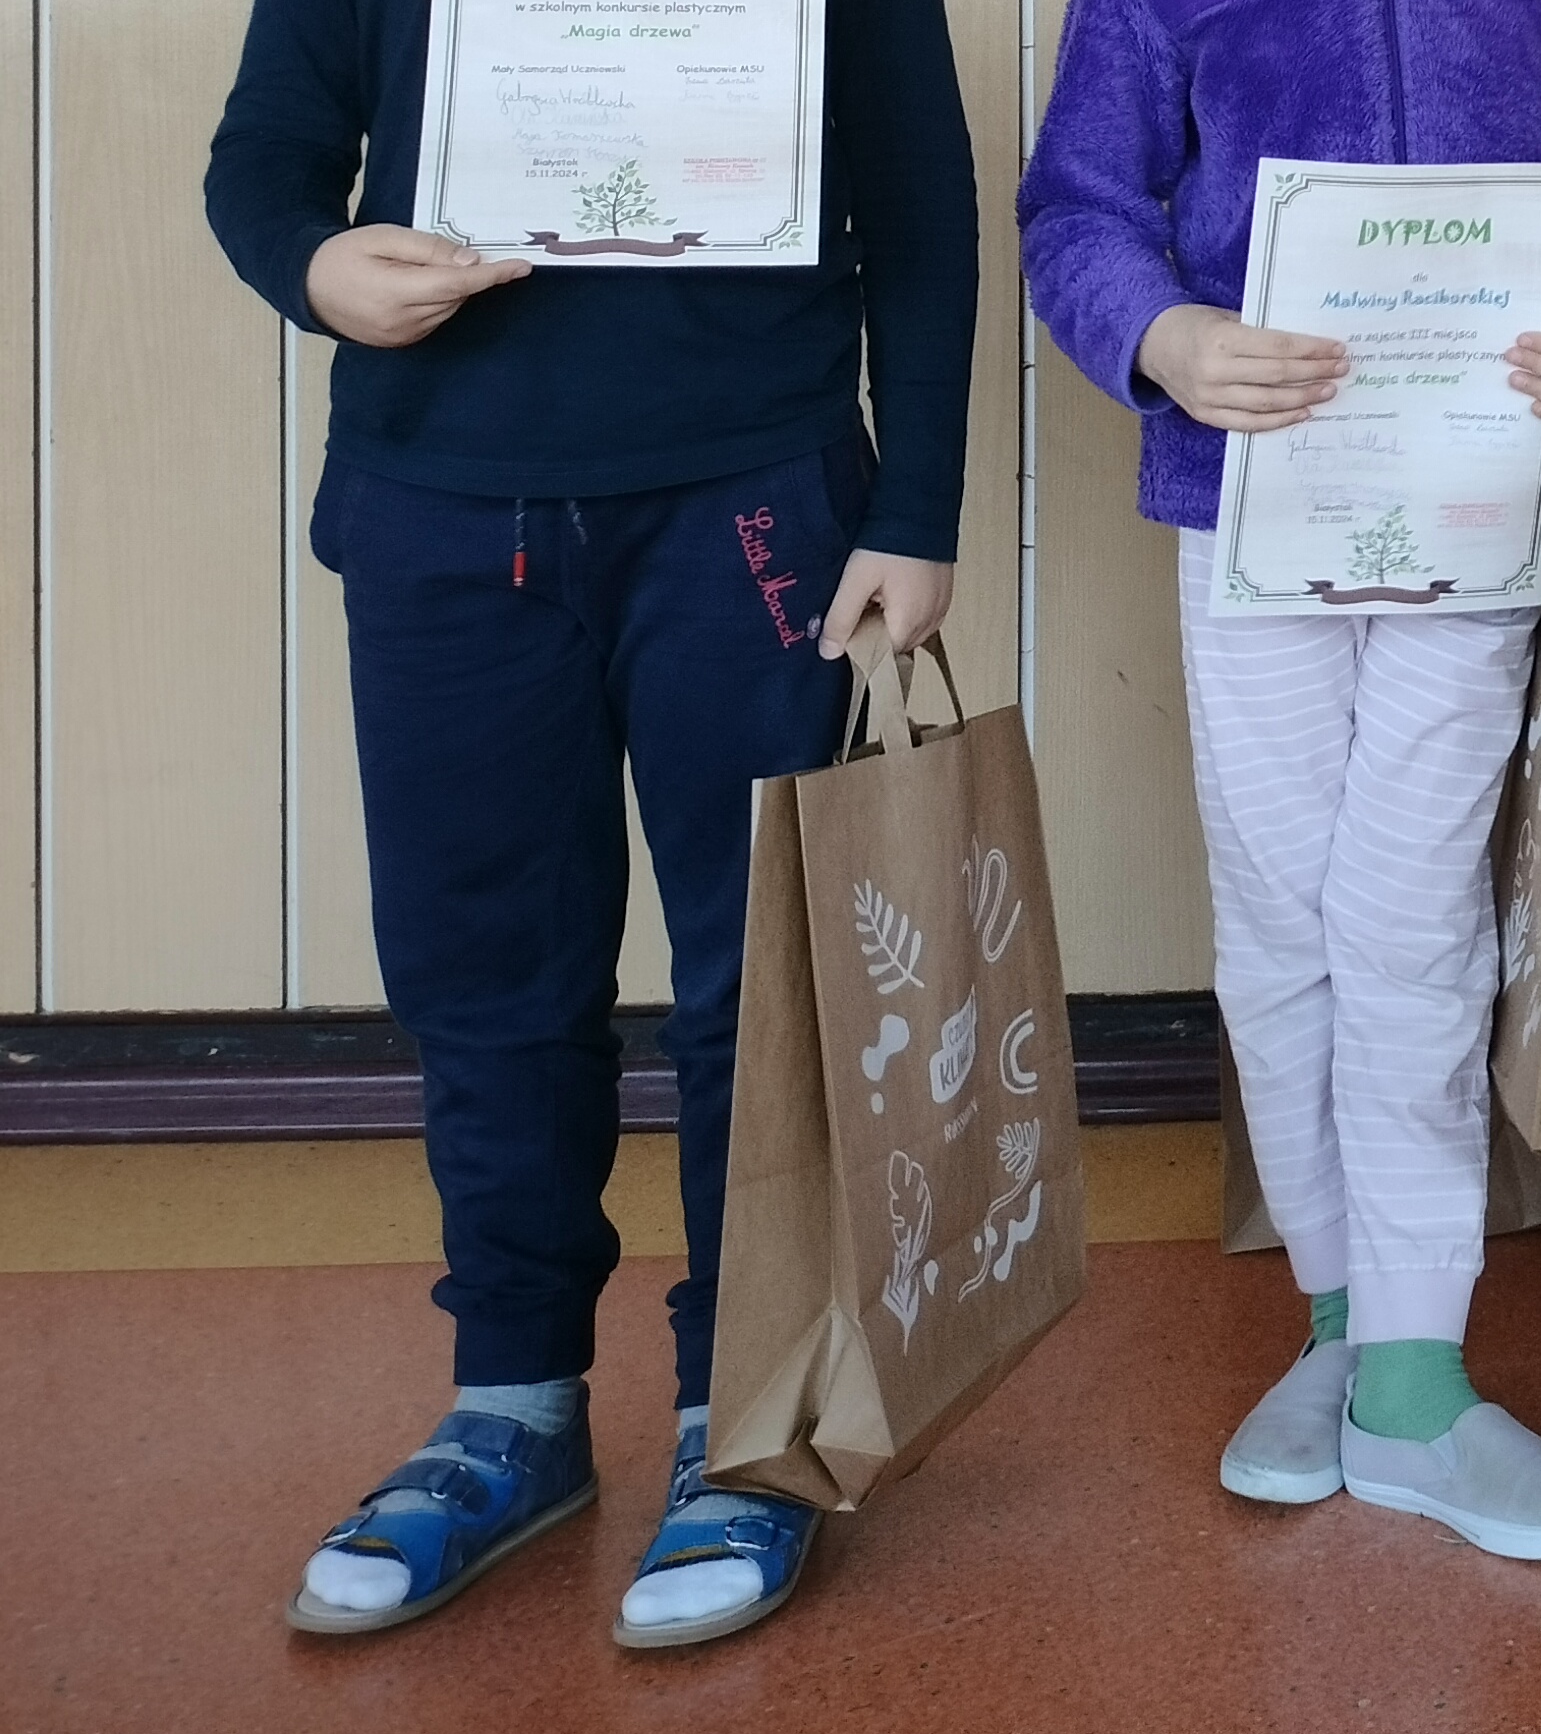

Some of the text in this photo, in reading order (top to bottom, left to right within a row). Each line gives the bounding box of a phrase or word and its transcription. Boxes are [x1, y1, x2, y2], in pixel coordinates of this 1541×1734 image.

[530, 1, 591, 14] szkolnym
[596, 2, 660, 12] konkursie
[665, 2, 746, 15] plastycznym
[677, 65, 736, 73] Opiekunowie
[525, 169, 578, 178] 15.11.2024
[1358, 218, 1492, 246] DYPLOM
[1380, 352, 1434, 362] konkursie
[735, 507, 805, 649] Little Marcel
